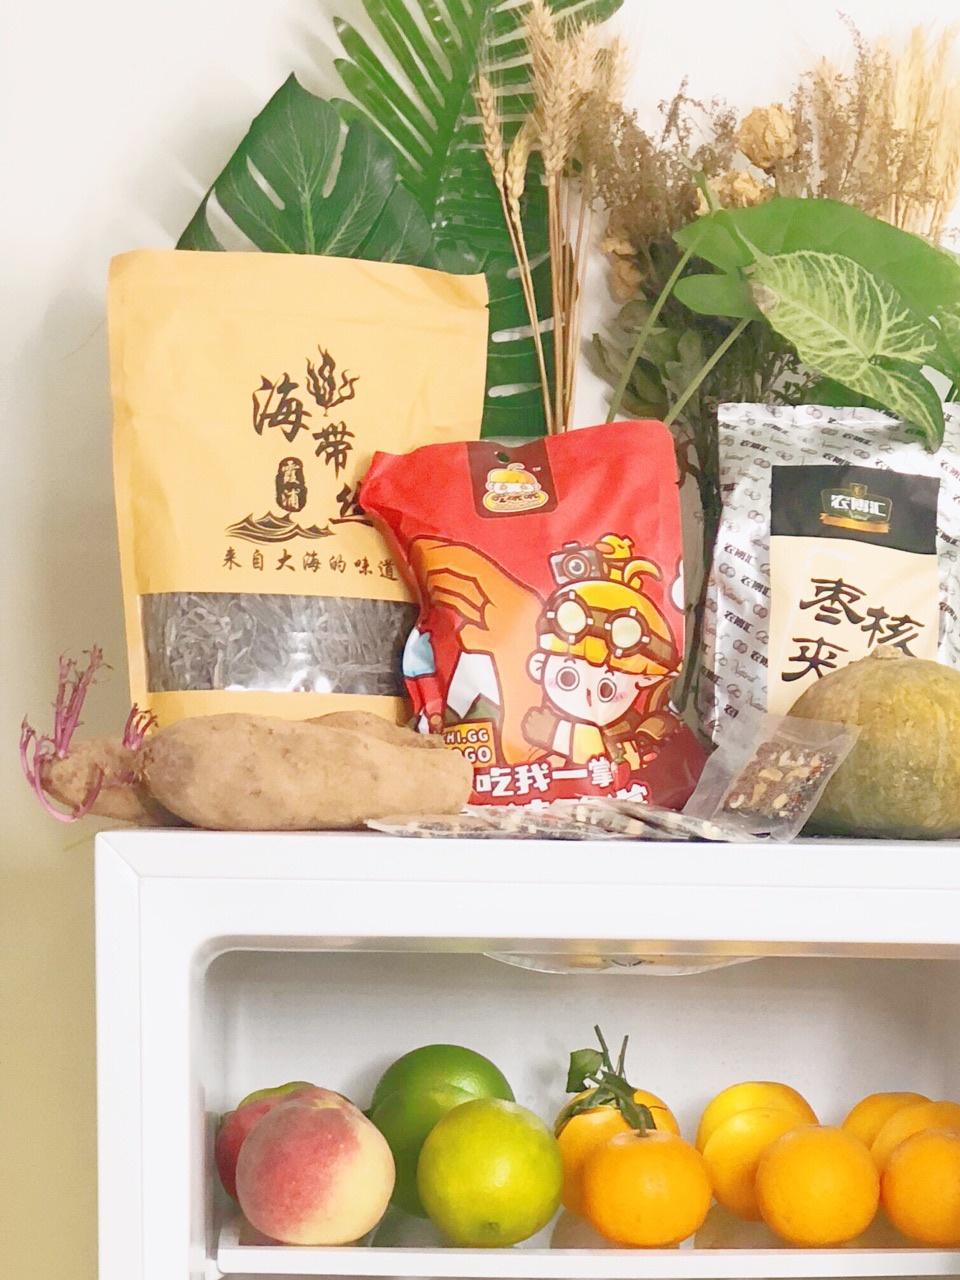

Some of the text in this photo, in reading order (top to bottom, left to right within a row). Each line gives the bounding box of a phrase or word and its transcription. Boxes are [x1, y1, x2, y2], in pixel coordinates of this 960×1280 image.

[222, 547, 400, 582] 来自大海的味道
[476, 756, 614, 797] 吃我一掌
